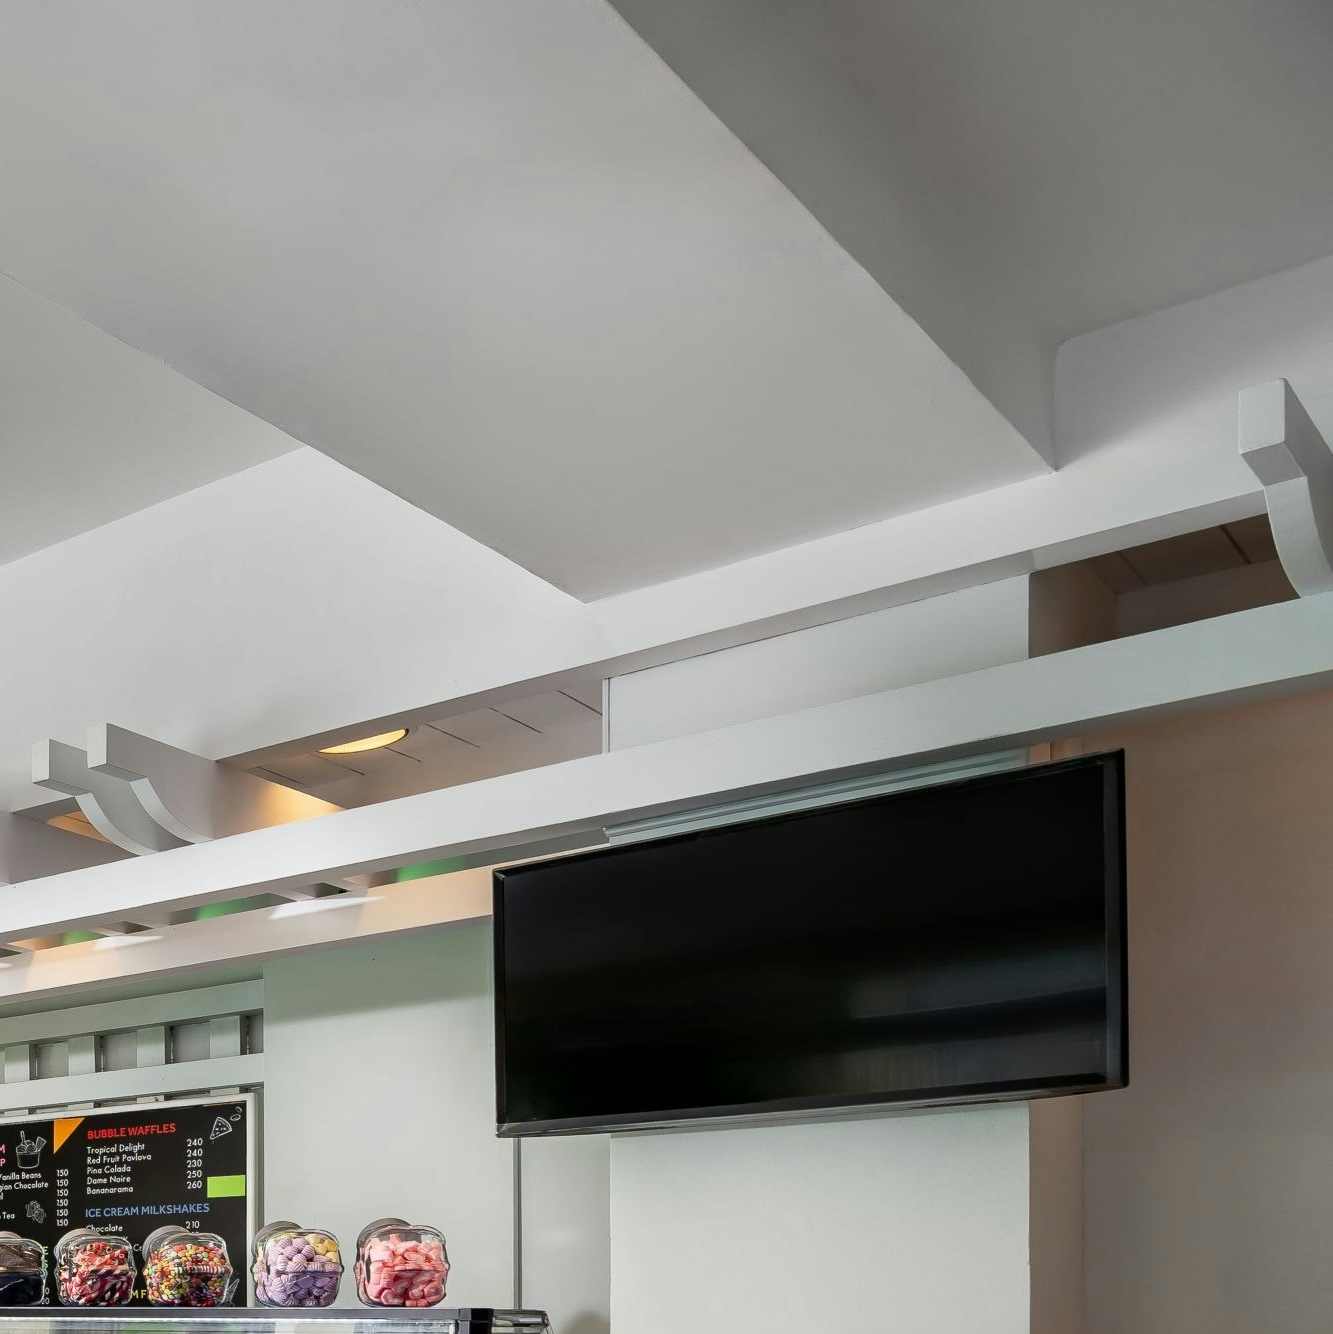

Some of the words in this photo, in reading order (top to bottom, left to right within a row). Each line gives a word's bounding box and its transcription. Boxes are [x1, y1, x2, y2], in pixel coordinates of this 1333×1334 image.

[87, 1127, 126, 1140] BUBBLE
[128, 1123, 176, 1136] WAFFLES
[86, 1144, 117, 1155] Tropical
[119, 1142, 145, 1154] Delight
[186, 1138, 203, 1147] 240
[86, 1156, 100, 1165] Red
[103, 1155, 120, 1163] Fruit
[122, 1153, 152, 1162] Pavlova
[186, 1149, 203, 1157] 240
[104, 1164, 131, 1174] Colada
[186, 1160, 203, 1168] 230
[21, 1171, 42, 1180] Beans
[56, 1169, 69, 1177] 150
[86, 1177, 107, 1185] Dame
[109, 1175, 131, 1183] Noire
[186, 1170, 203, 1179] 250
[14, 1180, 49, 1190] Chocolate
[56, 1179, 69, 1187] 150
[86, 1186, 134, 1195] Bananarama
[186, 1181, 203, 1189] 260
[56, 1189, 69, 1197] 150
[56, 1199, 69, 1207] 150
[2, 1211, 15, 1220] Tea
[56, 1209, 69, 1217] 150
[85, 1208, 101, 1218] ICE
[103, 1206, 139, 1217] CREAM
[141, 1203, 210, 1215] MILKSHAKES
[56, 1219, 69, 1227] 150
[86, 1223, 123, 1232] Chocolate
[185, 1221, 200, 1229] 210
